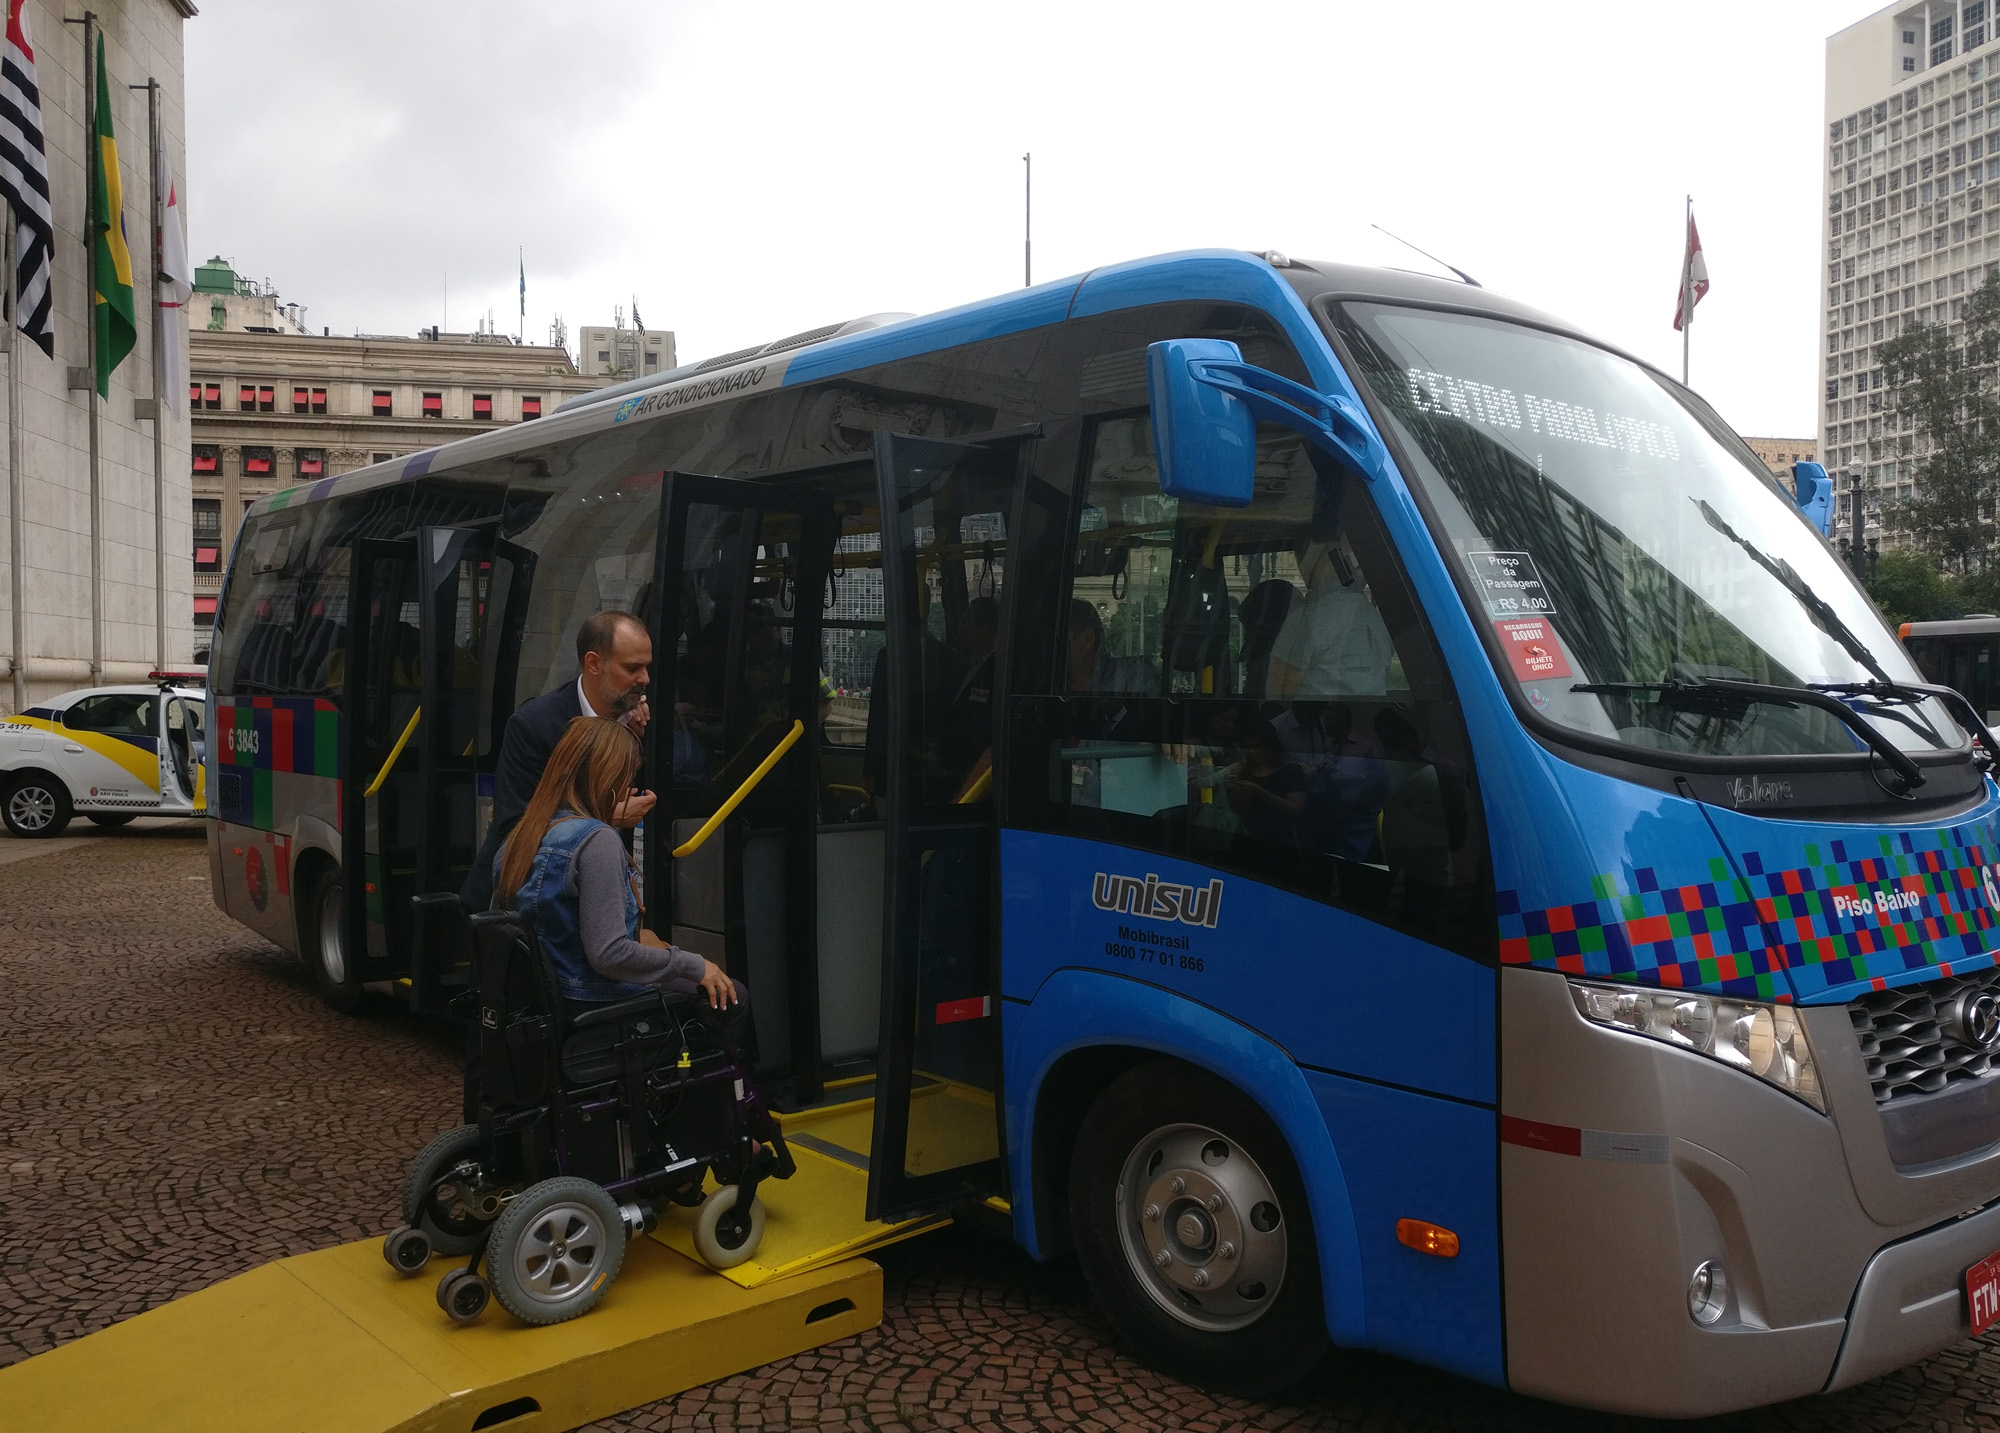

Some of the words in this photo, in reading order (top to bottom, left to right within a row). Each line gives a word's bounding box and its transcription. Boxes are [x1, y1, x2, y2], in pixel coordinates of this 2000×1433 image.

[634, 395, 657, 416] AR
[657, 366, 767, 410] CONDICIONADO
[1407, 368, 1523, 430] CENTRO
[1488, 556, 1519, 567] Preço
[1503, 567, 1516, 576] da
[1486, 579, 1541, 590] Passagem
[1499, 597, 1519, 610] R$
[1521, 597, 1548, 610] 4,00
[1504, 623, 1543, 631] RECARREGUE
[1512, 629, 1544, 641] AQUI!
[1525, 656, 1554, 665] BILHETE
[228, 727, 235, 751] 6
[236, 728, 260, 754] 3843
[1092, 873, 1223, 928] unisul
[1833, 895, 1873, 918] Piso
[1874, 888, 1920, 913] Baixo
[1118, 926, 1189, 950] Mobibrasil
[1105, 942, 1136, 960] 0800
[1139, 948, 1155, 962] 77
[1159, 951, 1174, 967] 01
[1179, 955, 1205, 972] 866
